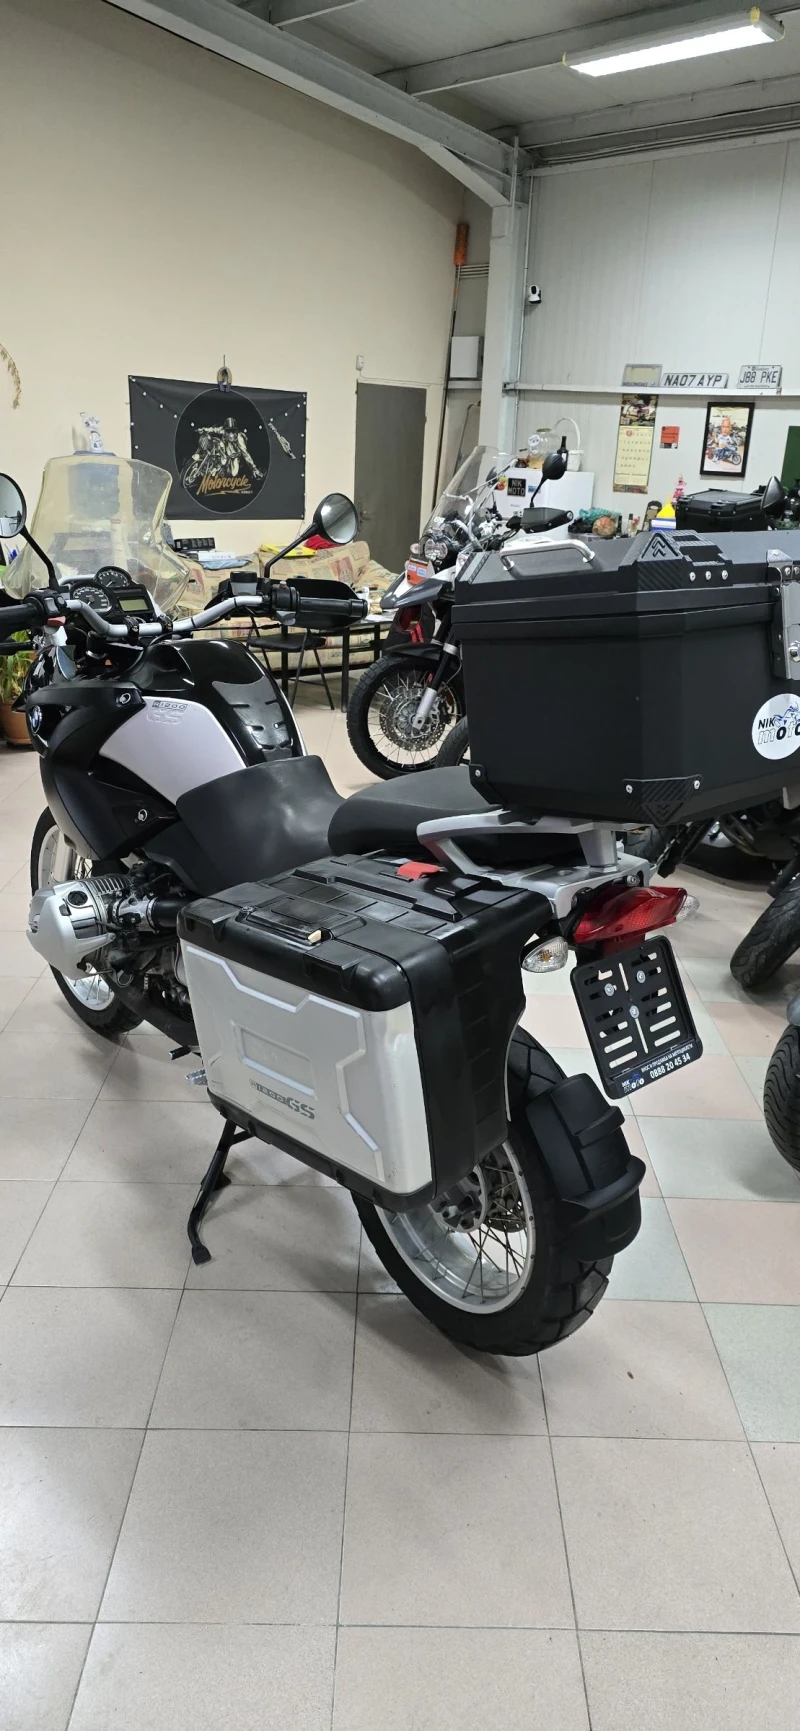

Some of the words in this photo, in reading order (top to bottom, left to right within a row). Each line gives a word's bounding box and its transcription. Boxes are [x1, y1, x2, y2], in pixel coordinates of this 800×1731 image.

[663, 374, 697, 387] NA07
[696, 374, 723, 387] AYP
[760, 370, 779, 384] PKE
[196, 474, 252, 496] Motorcycle
[511, 479, 523, 487] NIK
[508, 487, 525, 496] MOTO
[757, 717, 776, 730] NIK
[649, 1065, 666, 1079] 0888
[665, 1061, 675, 1072] 20
[674, 1056, 683, 1067] 45
[681, 1052, 691, 1063] 34
